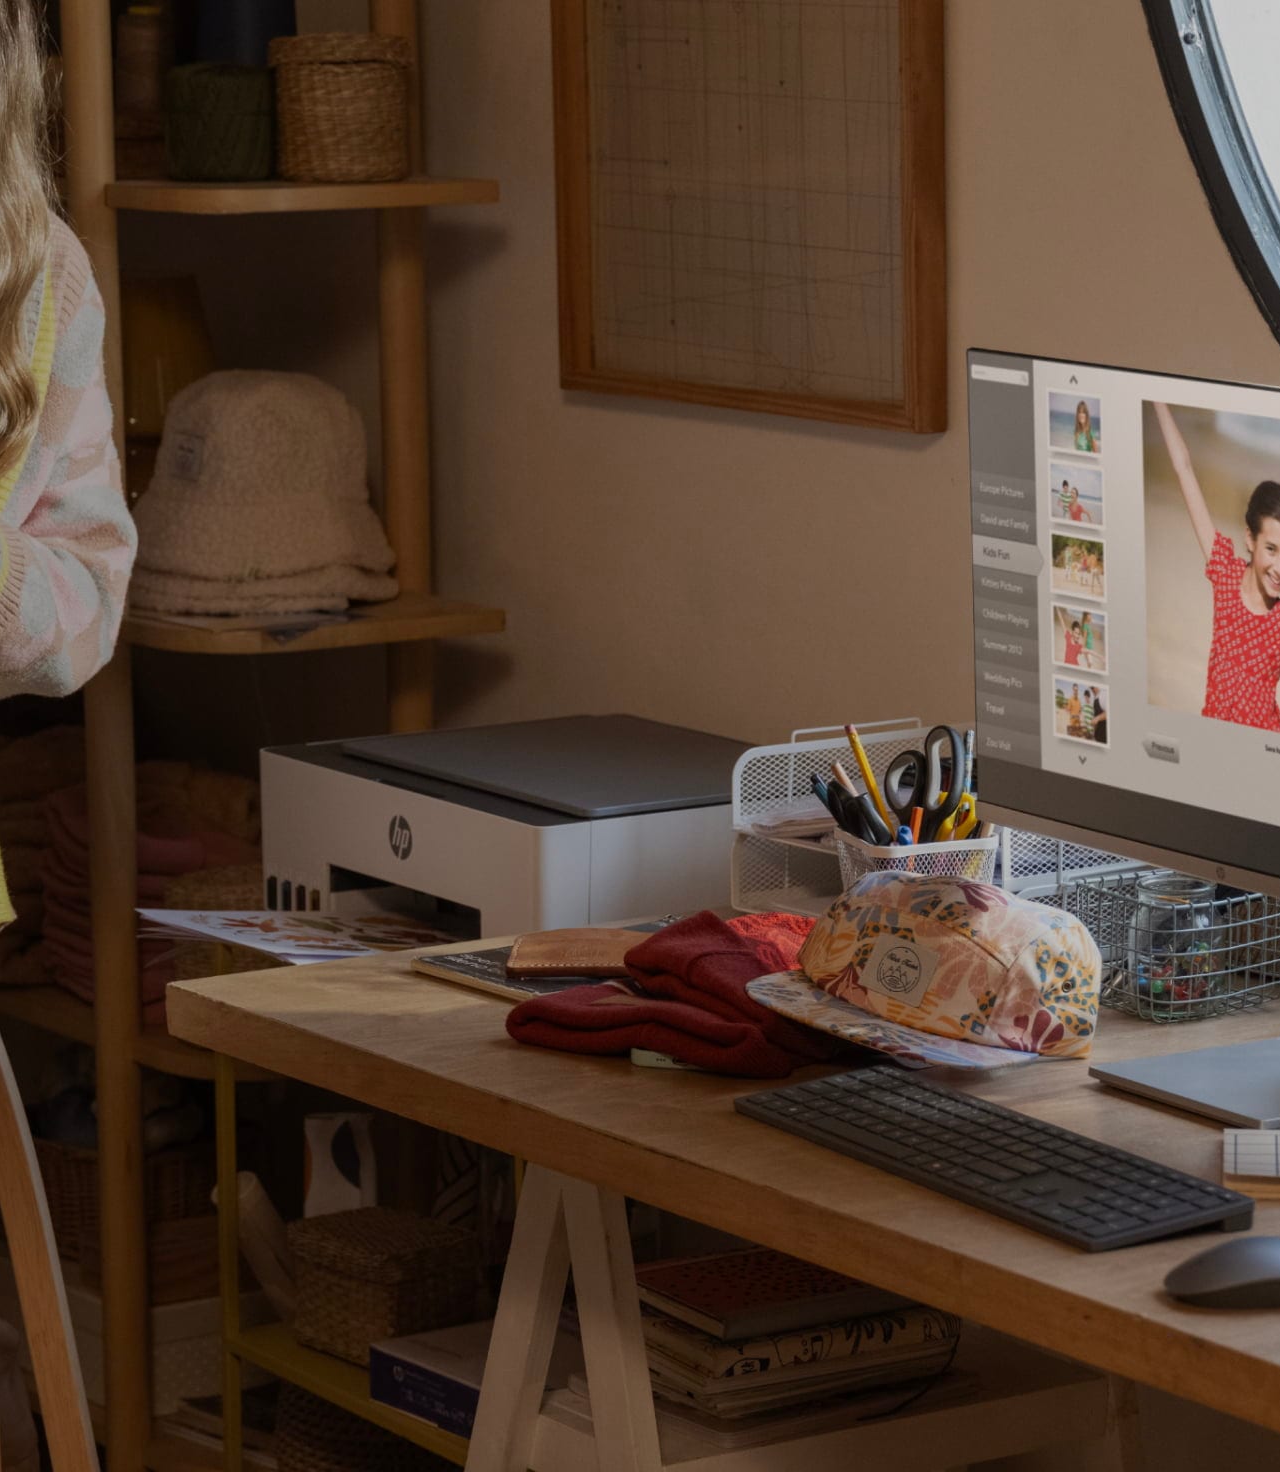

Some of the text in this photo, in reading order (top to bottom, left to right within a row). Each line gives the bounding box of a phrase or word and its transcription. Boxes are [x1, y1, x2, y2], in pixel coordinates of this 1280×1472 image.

[979, 482, 1024, 499] Europe Pictures
[980, 513, 1030, 533] David and Family
[983, 546, 1010, 561] Kids Fun
[1000, 580, 1023, 594] Pictures
[982, 608, 1029, 629] Children Playing
[982, 638, 1007, 651] Summer
[983, 672, 1010, 688] Wedding
[985, 702, 1005, 715] Travel
[986, 737, 998, 748] Zoo
[390, 815, 412, 861] hp
